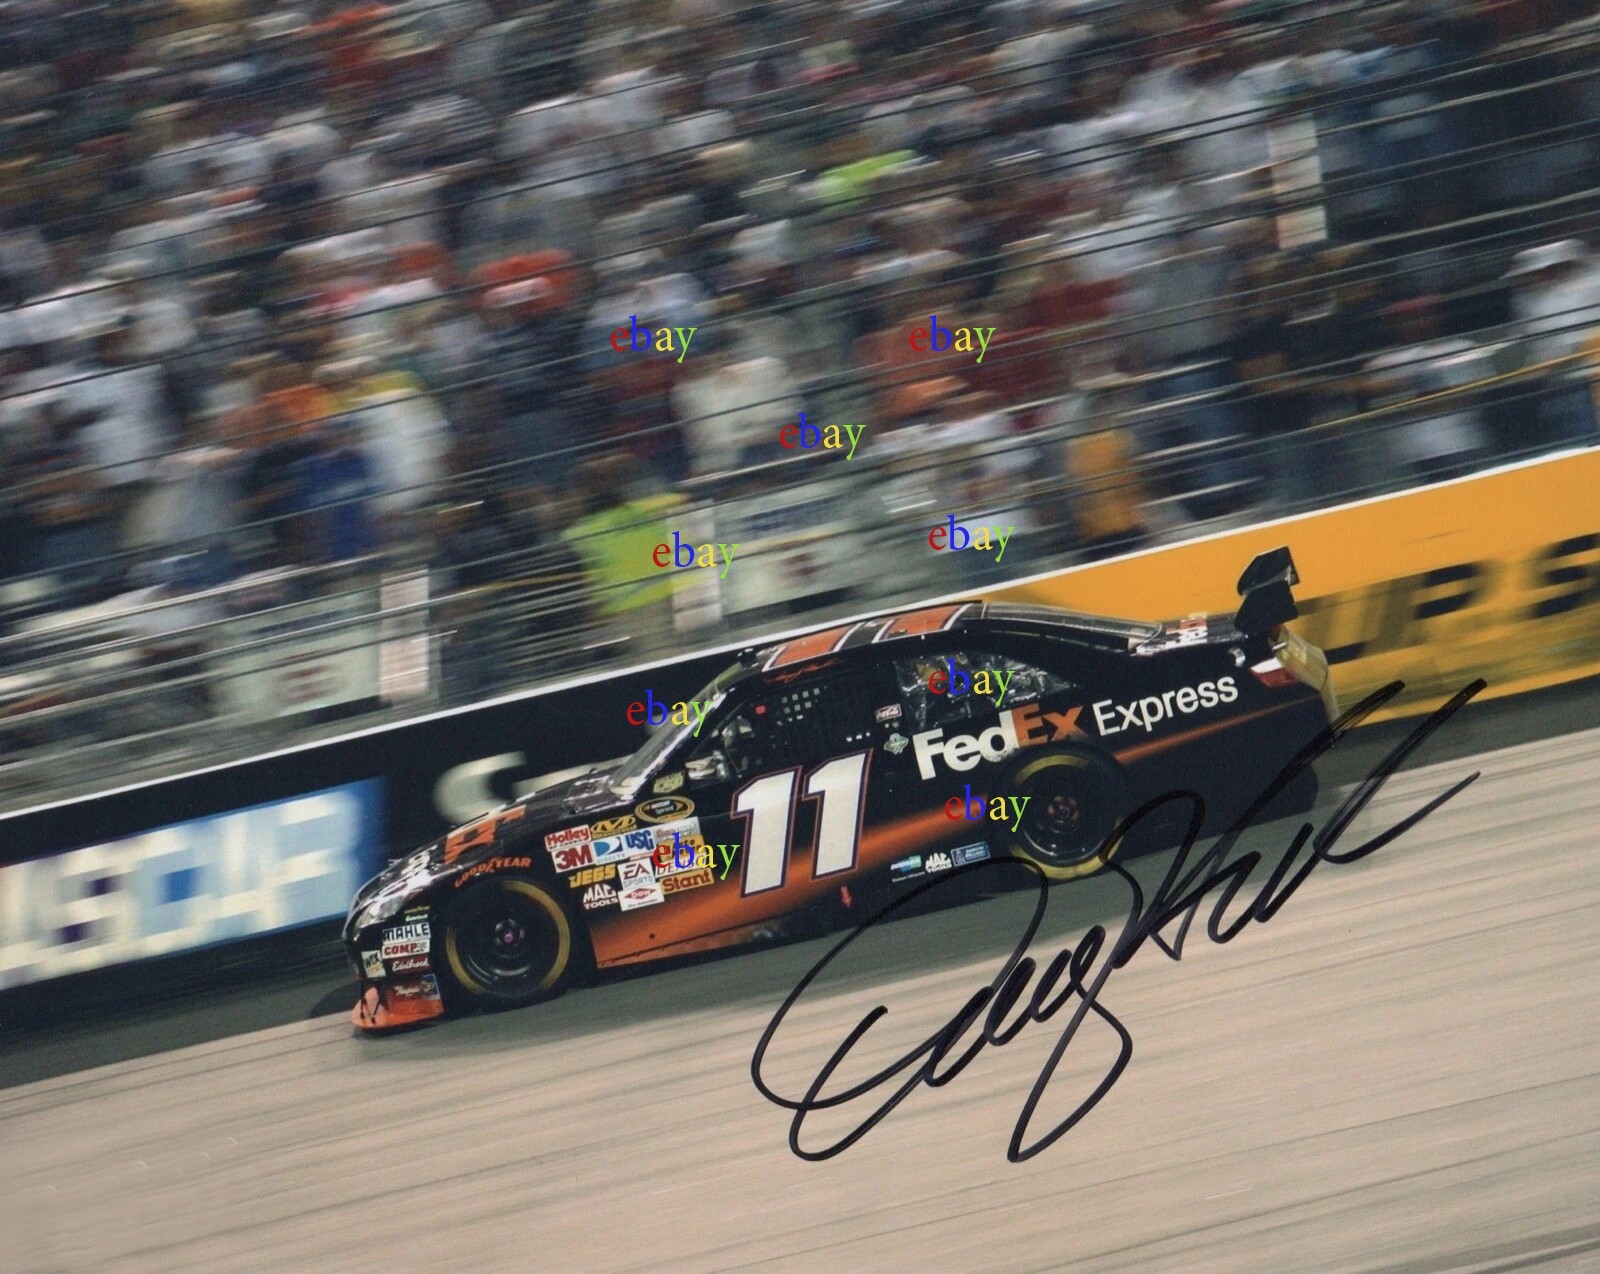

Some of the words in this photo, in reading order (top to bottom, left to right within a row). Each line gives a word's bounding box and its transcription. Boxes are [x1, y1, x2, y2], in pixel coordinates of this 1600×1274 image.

[911, 703, 1091, 780] FedEx
[1092, 676, 1239, 736] Express
[730, 748, 873, 898] 11
[546, 828, 590, 846] Holley
[625, 829, 655, 851] USG
[555, 844, 593, 870] 3M
[454, 856, 533, 888] GOODYEAR
[568, 863, 616, 889] JEGS
[623, 863, 650, 880] EA
[662, 869, 711, 892] Stant
[583, 883, 617, 904] MAC
[584, 897, 619, 910] TOOLS
[384, 923, 430, 942] MAHLE
[384, 942, 418, 956] COMP
